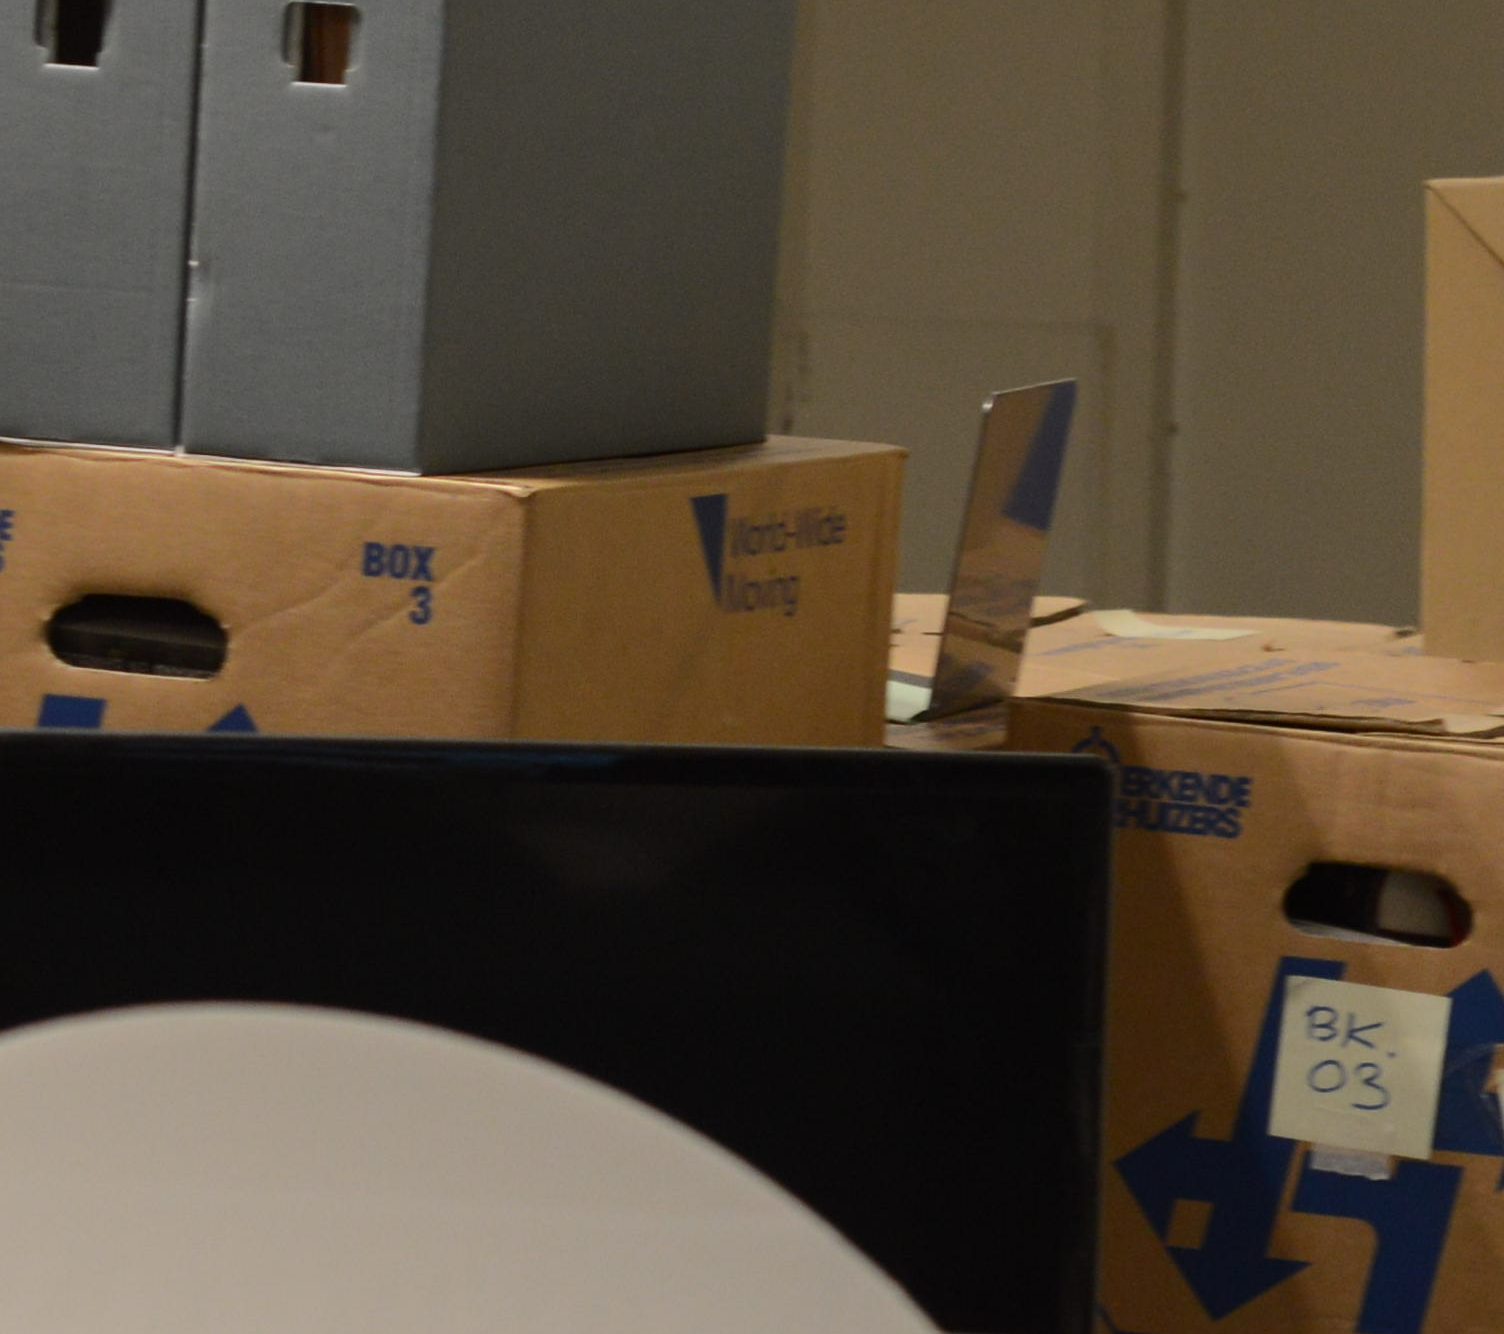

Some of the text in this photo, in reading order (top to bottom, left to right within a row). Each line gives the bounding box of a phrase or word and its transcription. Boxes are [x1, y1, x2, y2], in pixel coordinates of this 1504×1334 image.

[361, 541, 436, 582] BOX
[408, 585, 433, 625] 3
[1121, 766, 1253, 808] ERKENDE
[1305, 1058, 1393, 1112] 03
